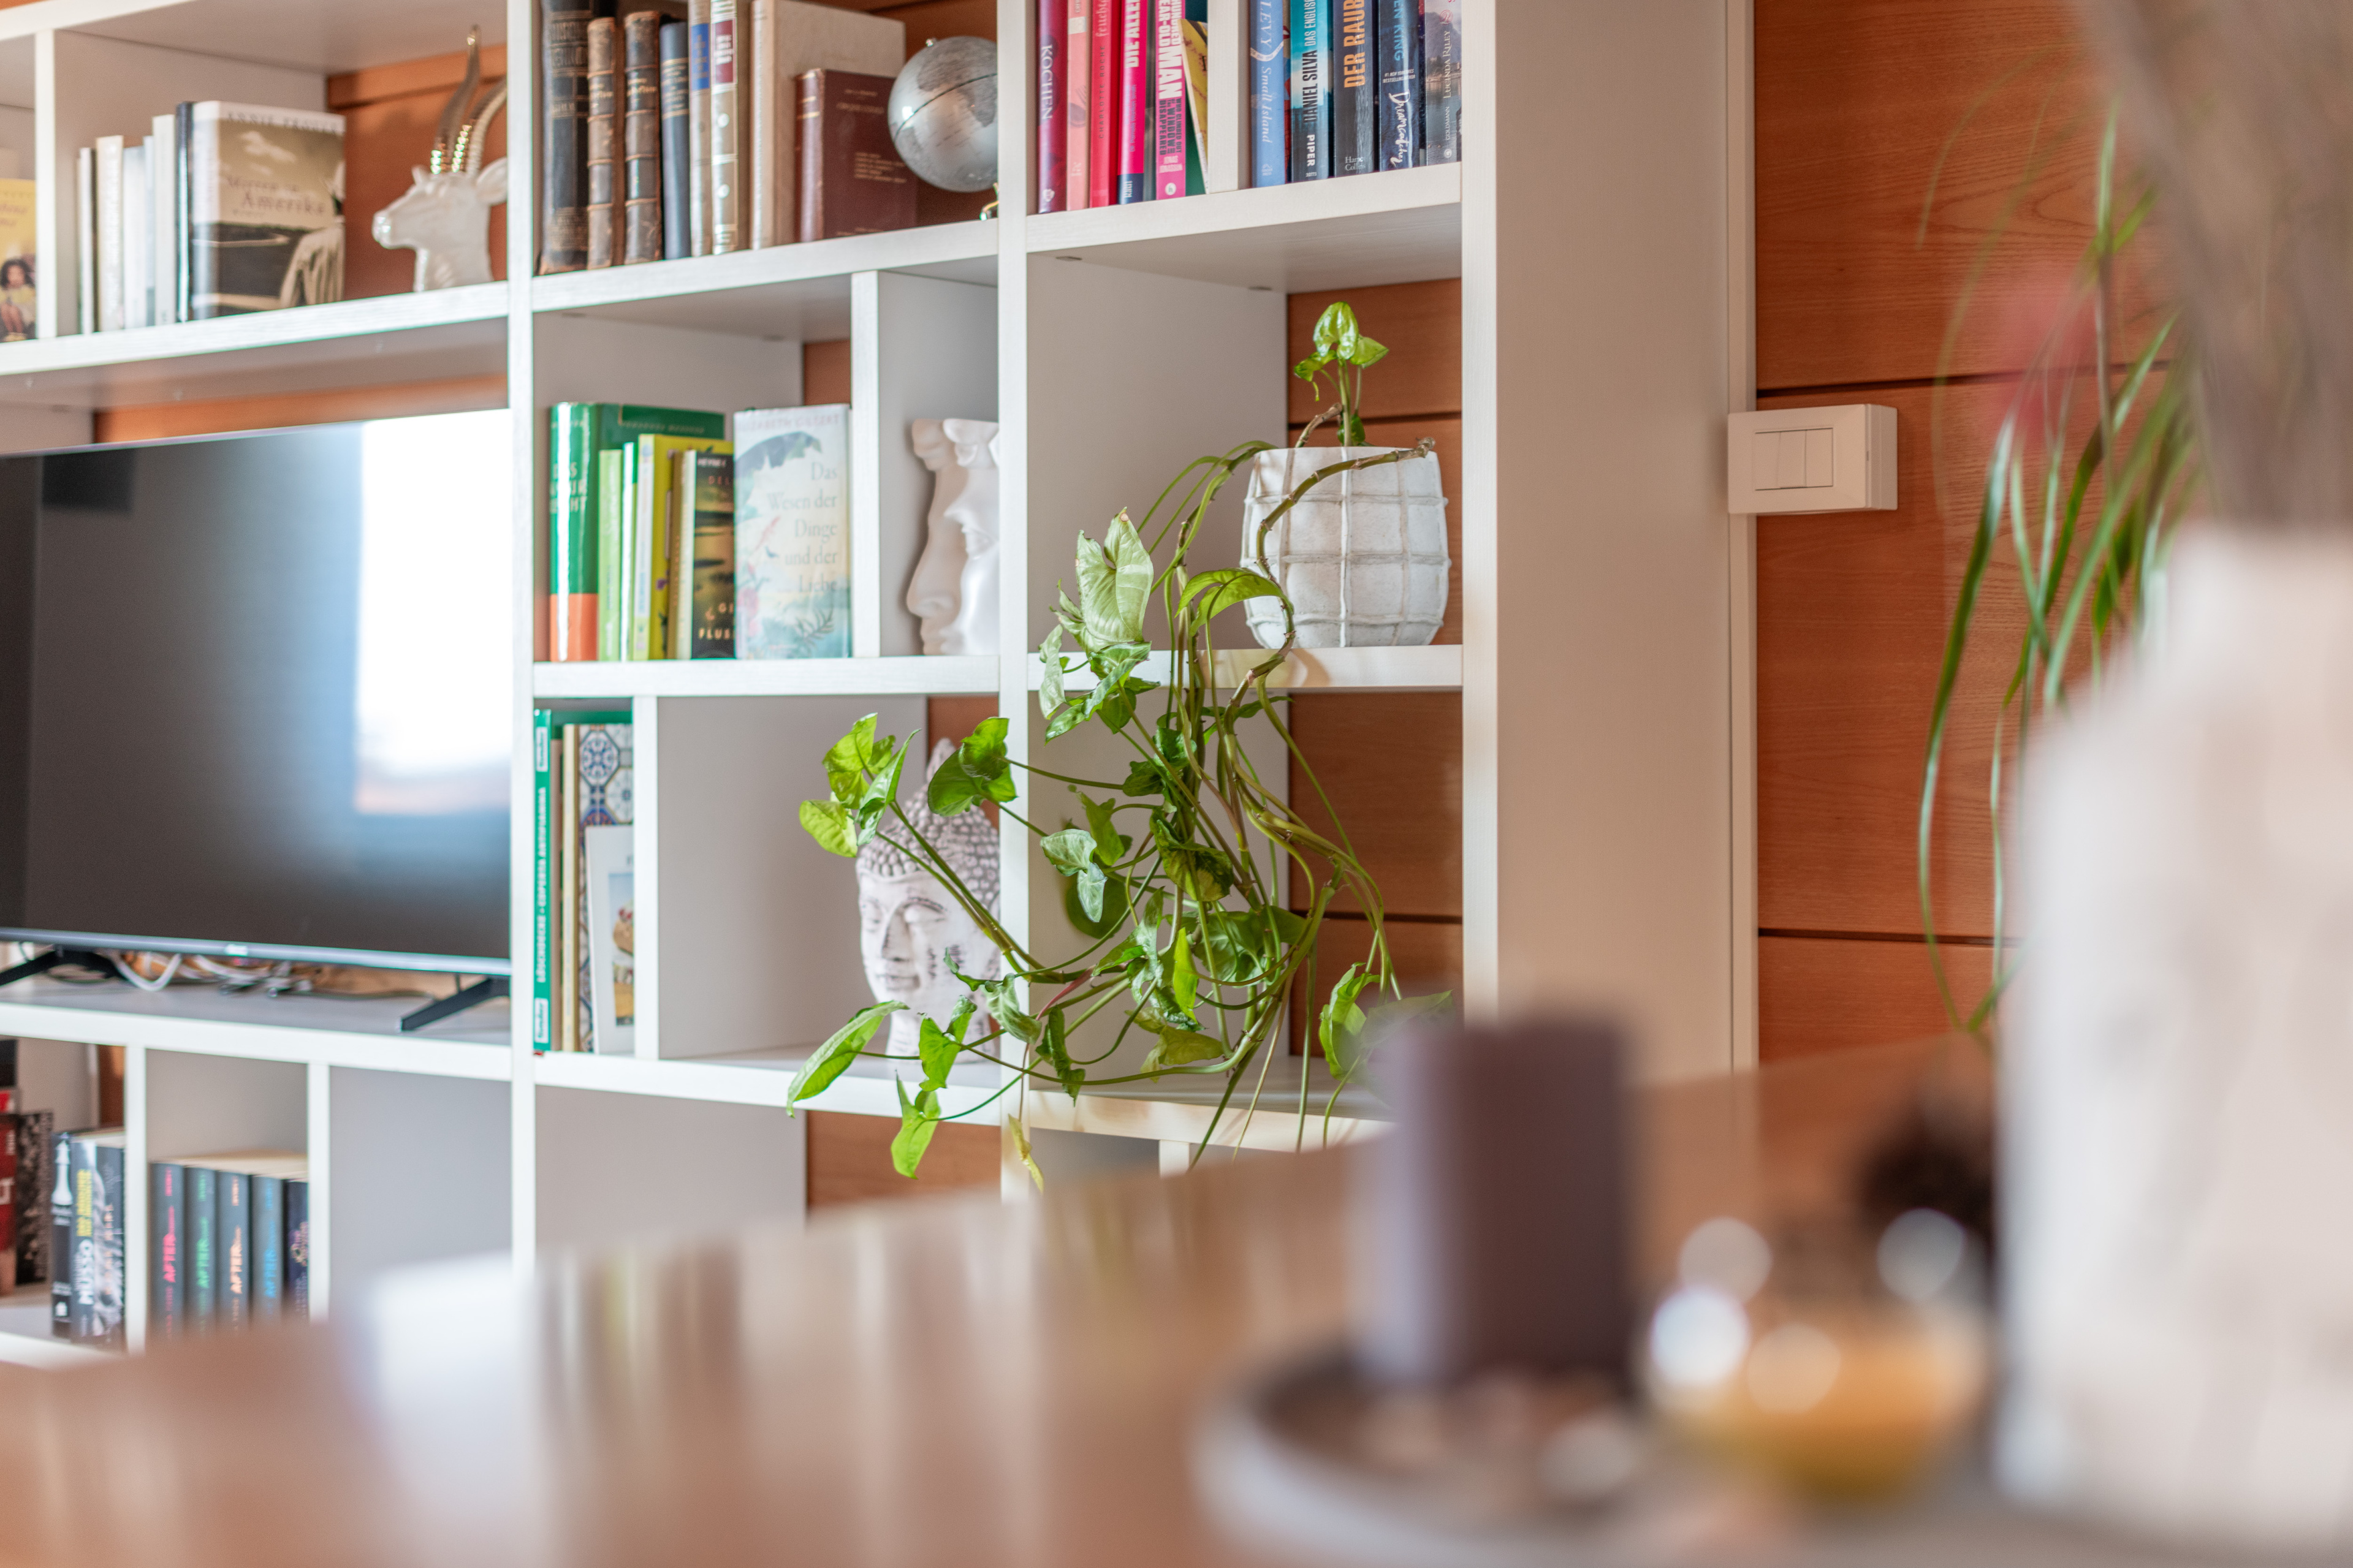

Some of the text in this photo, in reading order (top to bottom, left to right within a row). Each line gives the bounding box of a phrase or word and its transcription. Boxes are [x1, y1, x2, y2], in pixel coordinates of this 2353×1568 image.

[1095, 0, 1109, 37] feucht
[1260, 0, 1272, 48] LEVY
[1125, 41, 1139, 68] DIE
[1304, 31, 1316, 47] DAS
[1394, 25, 1405, 61] KING
[1040, 45, 1053, 120] KOCHEN
[1158, 45, 1182, 99] MAN
[1344, 52, 1366, 88] DER
[1443, 31, 1451, 99] LUCINDA RILEY
[1261, 66, 1272, 143] Small Island
[1302, 50, 1318, 123] DANIEL SILVA
[1167, 107, 1176, 147] WINDOW
[1389, 89, 1411, 167] Dreamcatcher
[1307, 134, 1316, 167] PIPER
[811, 461, 838, 480] Das
[767, 488, 838, 510] Wesen der
[795, 518, 838, 544] Dinge
[785, 545, 838, 565] und der
[799, 574, 838, 593] Liebe
[162, 1233, 176, 1282] AFTER
[230, 1243, 243, 1294] AFTER
